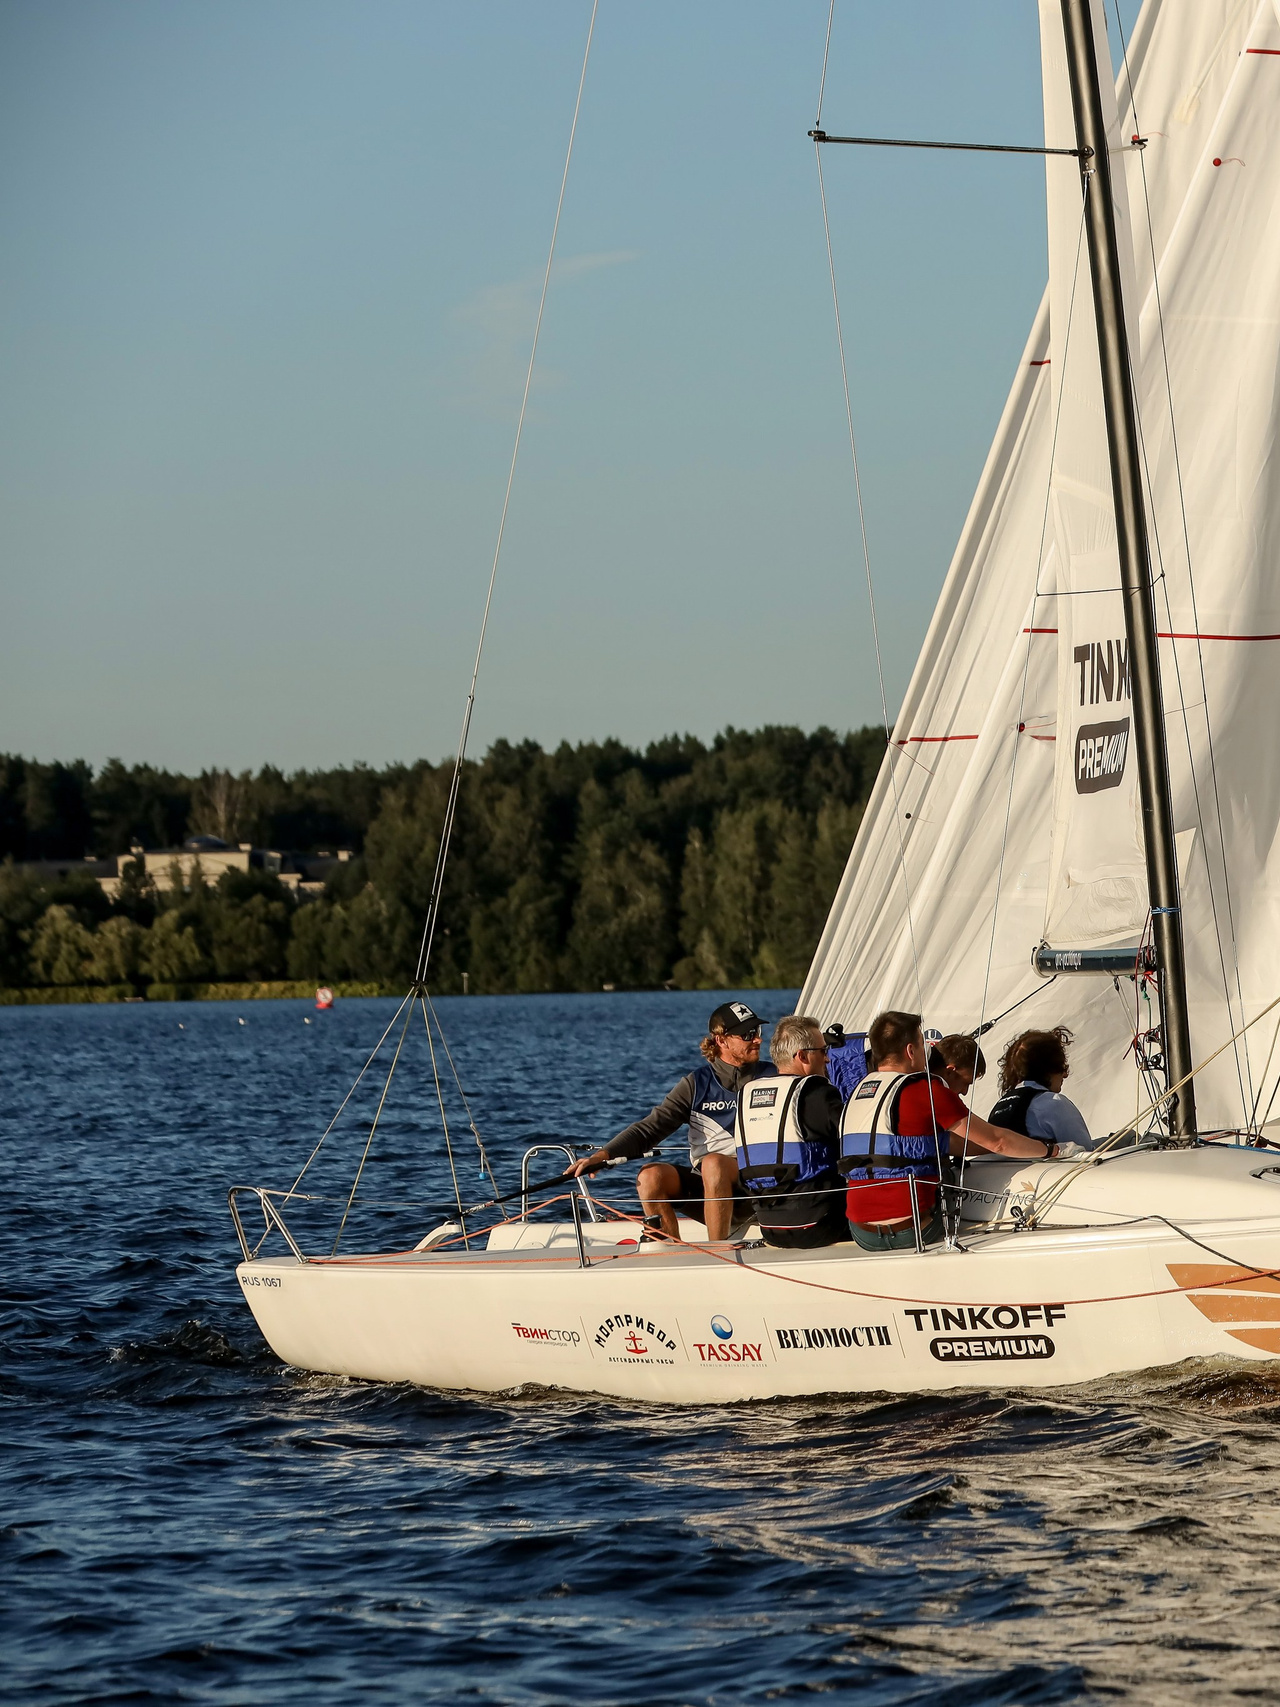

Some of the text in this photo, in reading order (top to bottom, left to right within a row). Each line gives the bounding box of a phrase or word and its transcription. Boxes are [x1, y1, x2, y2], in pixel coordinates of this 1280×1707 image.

[1078, 730, 1128, 780] PREMIUM
[241, 1276, 282, 1288] RUS 1067
[904, 1303, 1066, 1331] TINKOFF
[595, 1314, 677, 1351] МОРПРИБОР
[775, 1326, 892, 1351] ВЕДОМОСТИ
[693, 1343, 763, 1362] TASSAY
[937, 1339, 1048, 1357] PREMIUM
